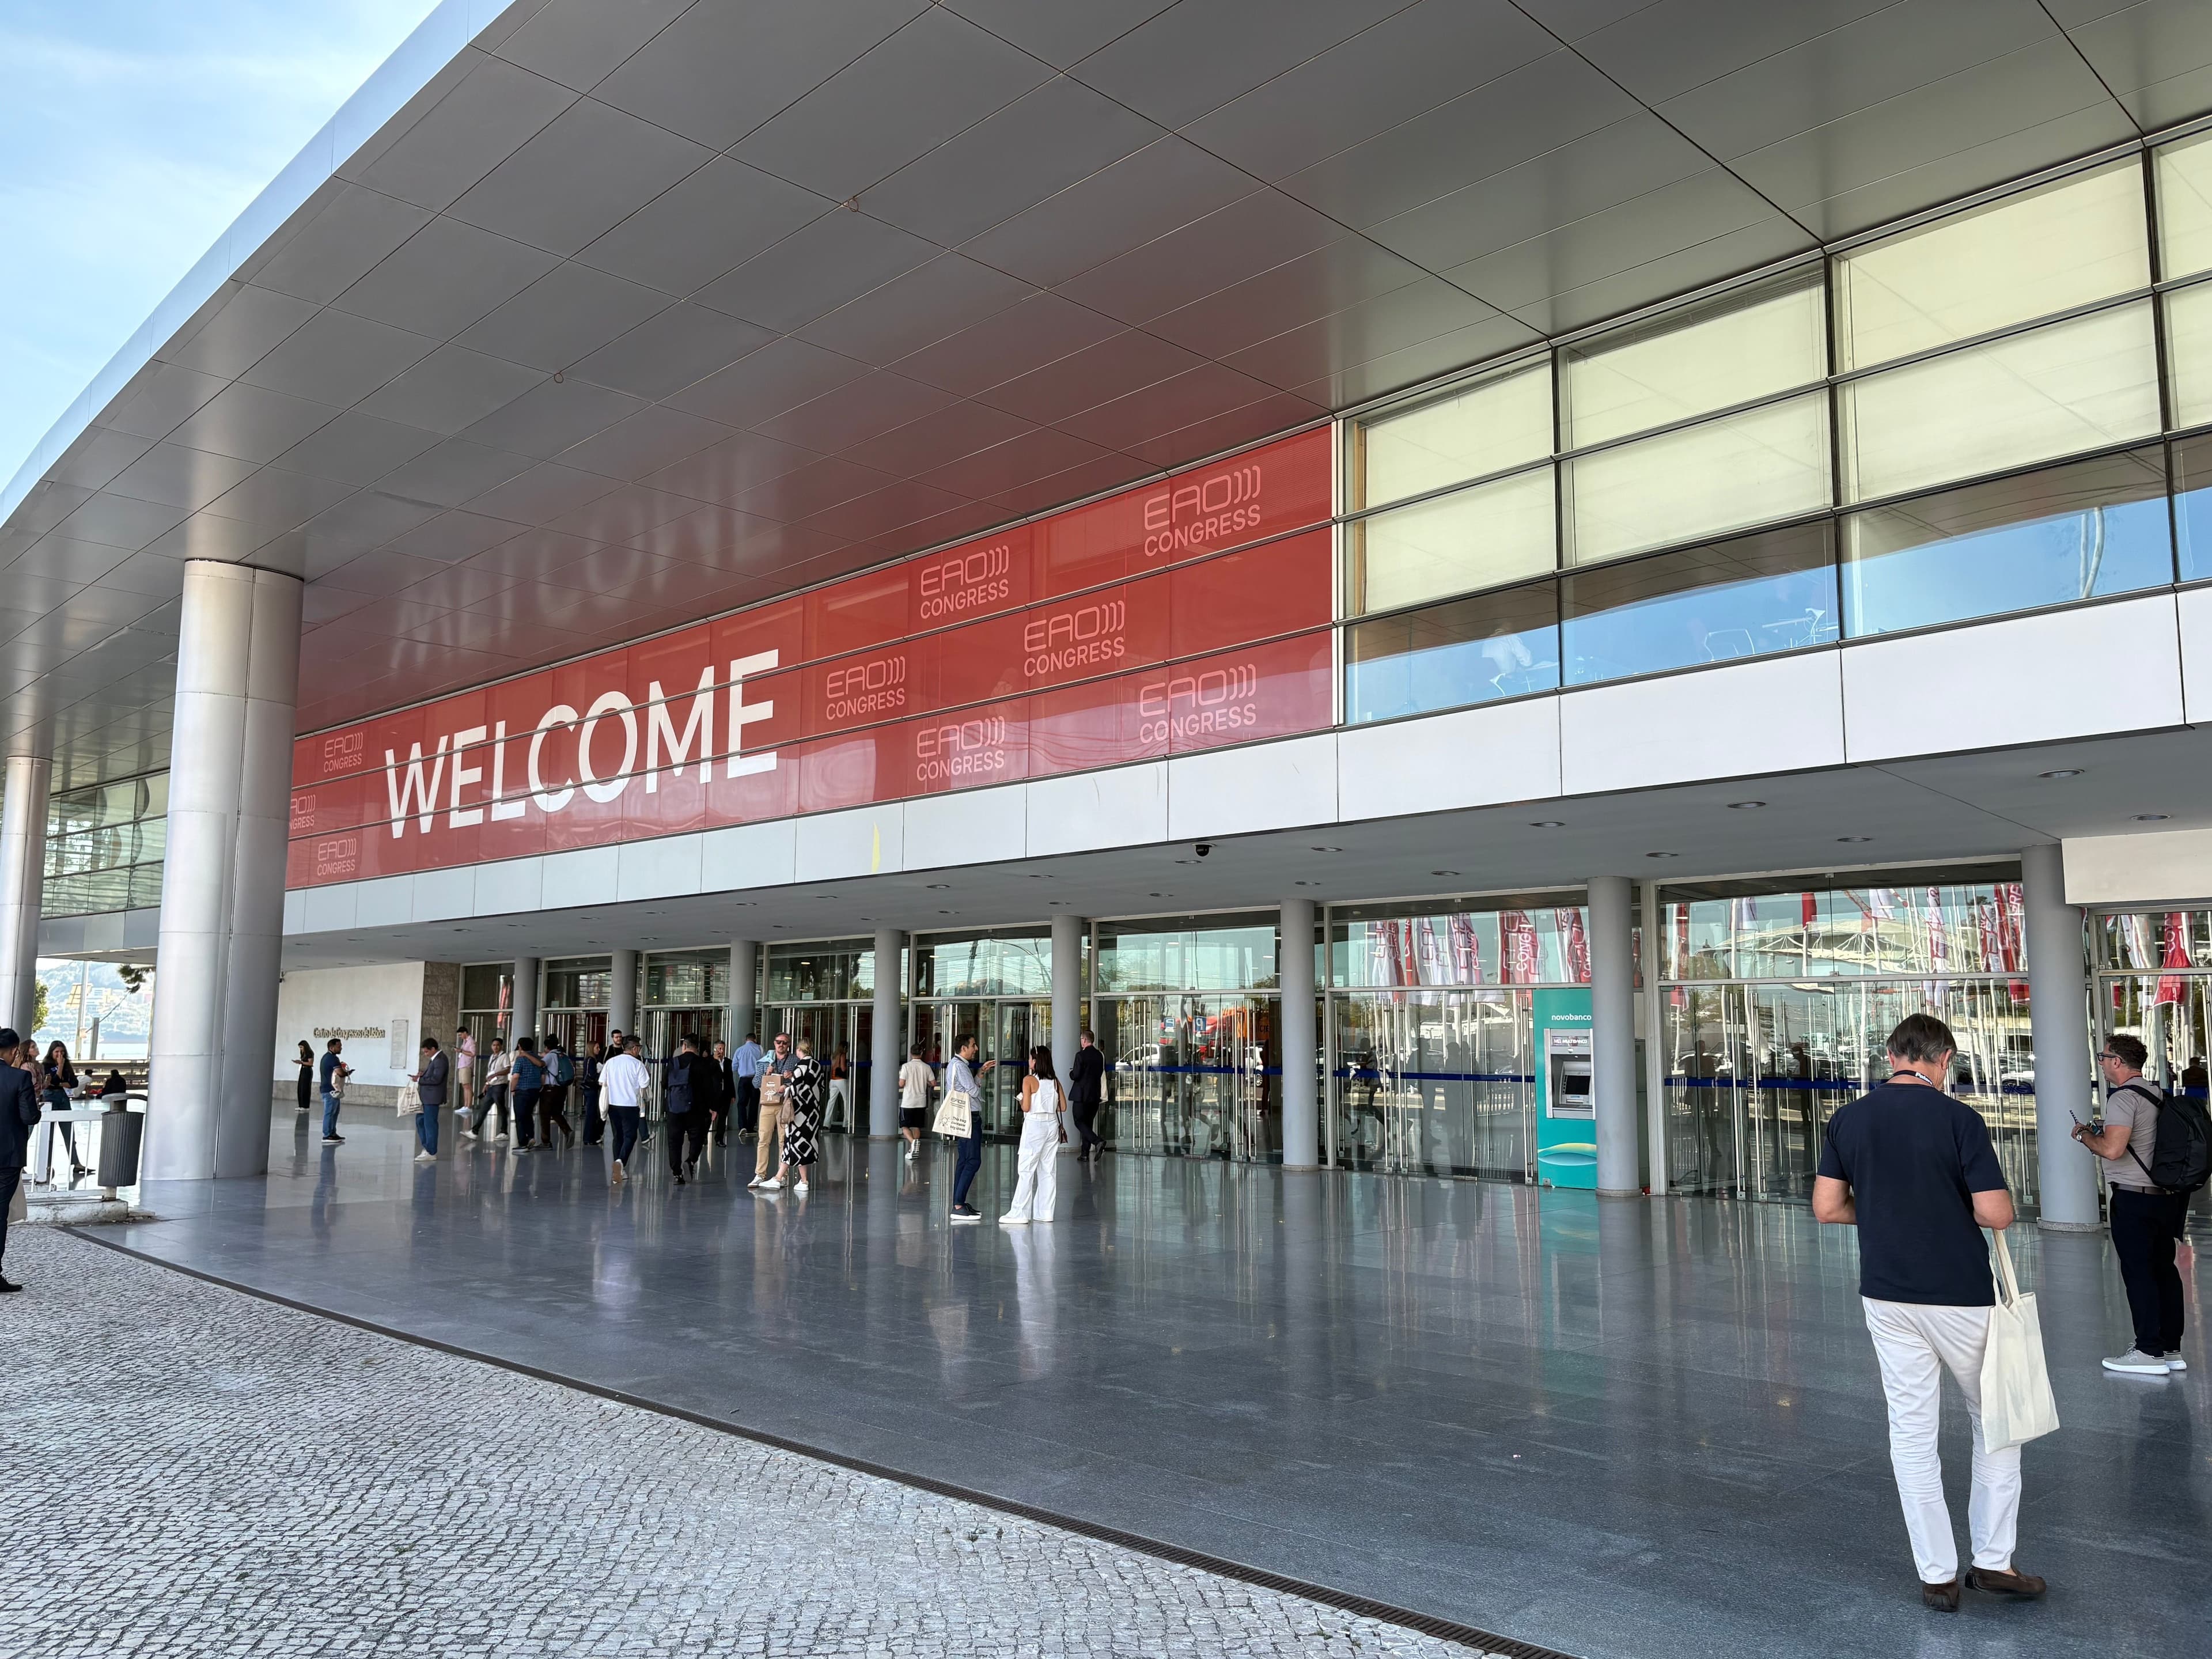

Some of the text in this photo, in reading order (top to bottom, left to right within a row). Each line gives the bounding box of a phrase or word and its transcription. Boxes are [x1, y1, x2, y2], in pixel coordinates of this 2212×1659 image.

[1145, 504, 1261, 557] CONGRESS
[921, 579, 1009, 619] CONGRESS
[1024, 637, 1125, 678] CONGRESS
[827, 688, 906, 721] CONGRESS
[1139, 703, 1257, 744] CONGRESS
[385, 649, 779, 839] WELCOME
[324, 753, 362, 772] CONGRESS
[917, 749, 1005, 782] CONGRESS
[289, 815, 315, 830] NGRESS
[317, 859, 355, 876] CONGRESS
